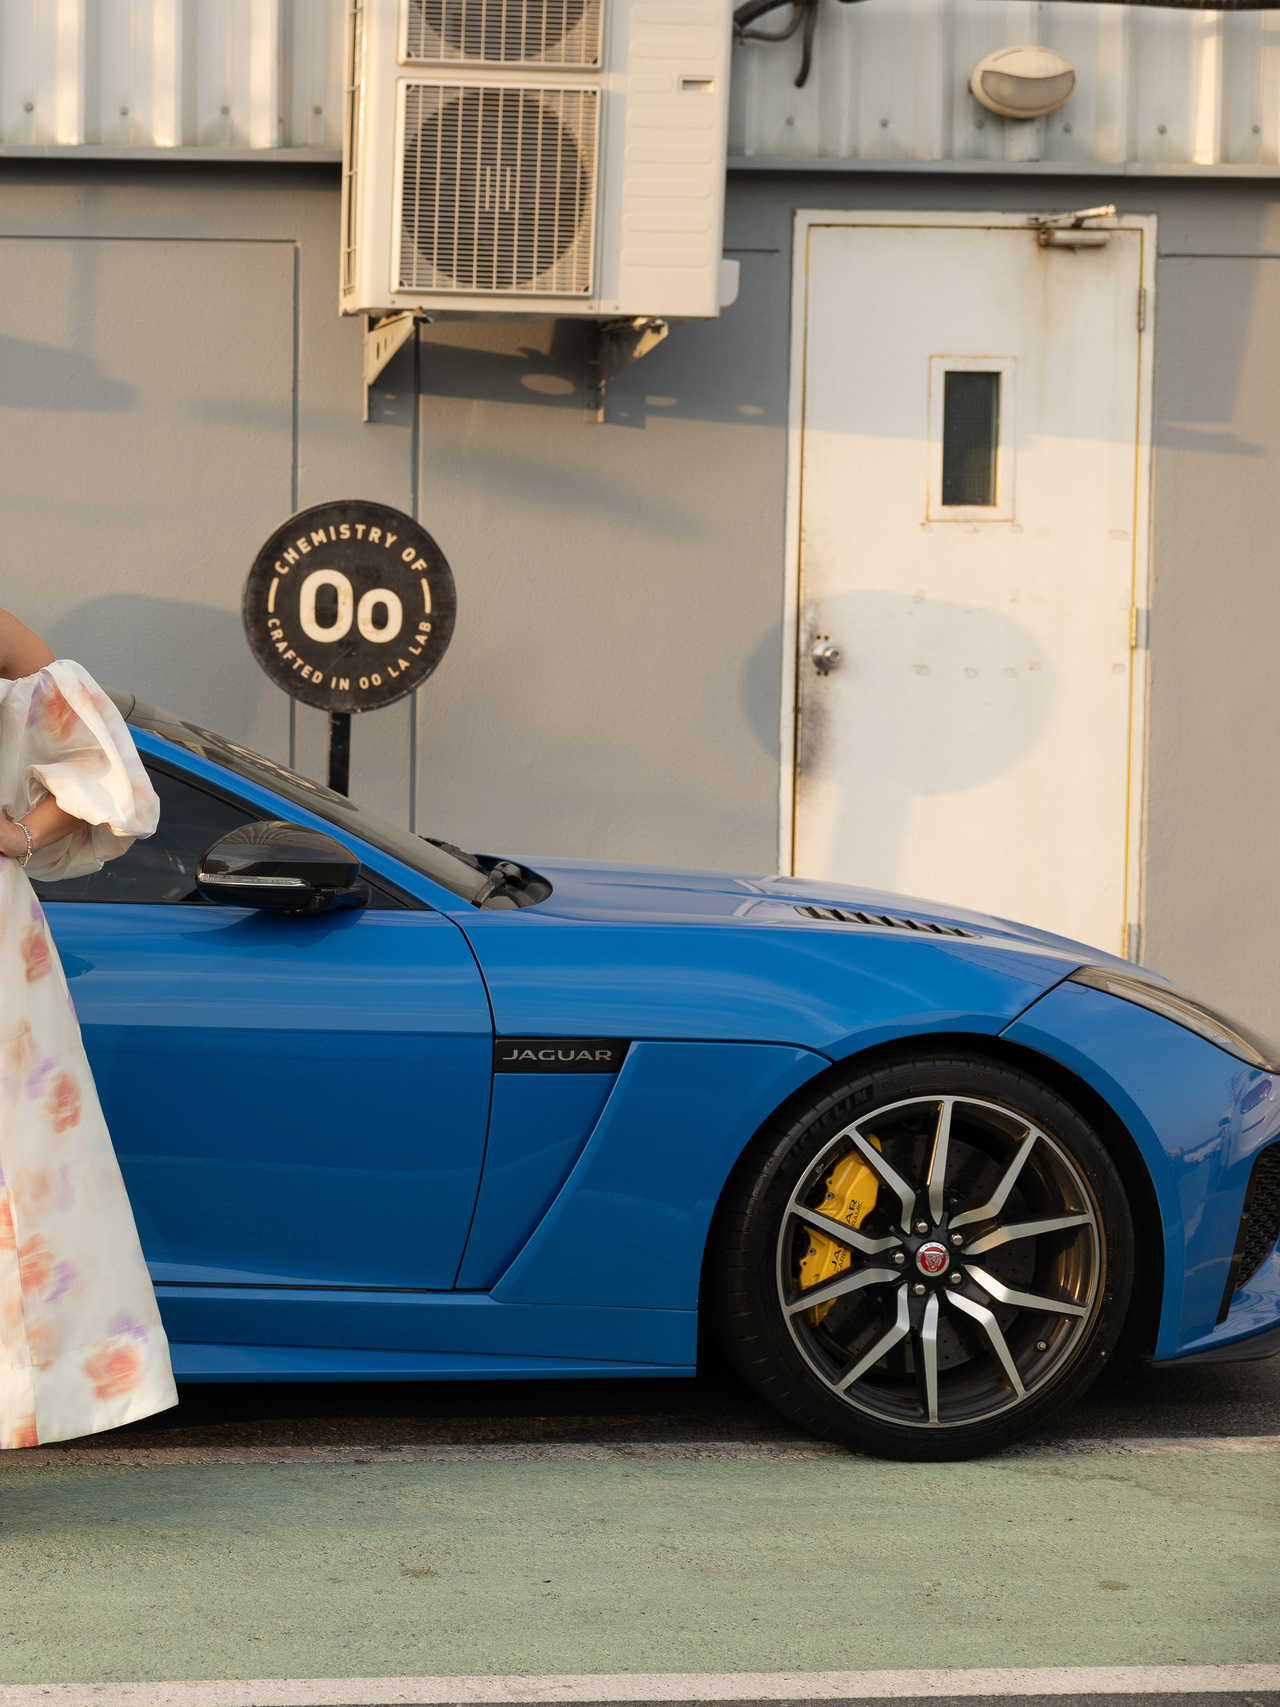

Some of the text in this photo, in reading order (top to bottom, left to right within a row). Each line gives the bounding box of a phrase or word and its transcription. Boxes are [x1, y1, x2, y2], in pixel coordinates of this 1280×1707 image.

[274, 523, 428, 575] CHEMISTRY OF
[267, 618, 324, 685] CRAFTED
[330, 676, 350, 691] IN
[387, 658, 410, 678] LA
[409, 621, 432, 655] LAB
[502, 1050, 612, 1061] JAGUAR
